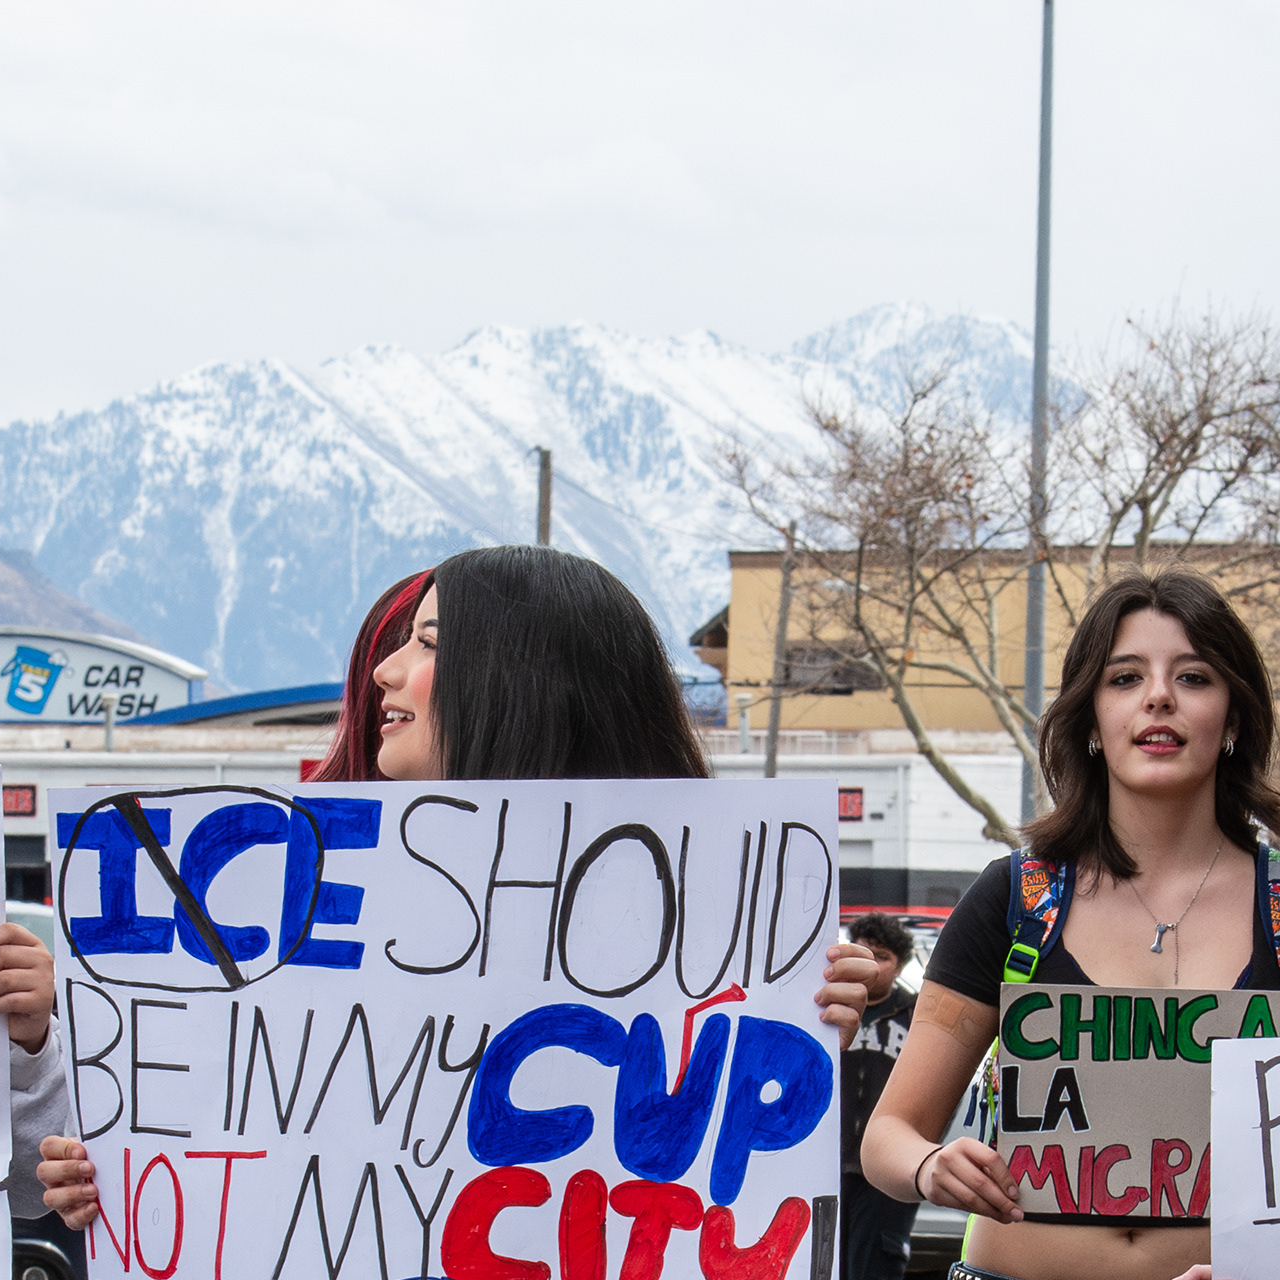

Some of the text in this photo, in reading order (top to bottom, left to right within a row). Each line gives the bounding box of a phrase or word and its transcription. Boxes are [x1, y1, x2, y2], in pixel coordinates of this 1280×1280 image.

[14, 672, 48, 703] 5
[84, 665, 144, 688] CAR
[57, 796, 383, 970] ICE
[1001, 992, 1280, 1064] CHINGA
[65, 977, 192, 1141] BE
[224, 1002, 313, 1136] IN
[467, 1003, 835, 1206] CUP
[1000, 1064, 1091, 1134] LA
